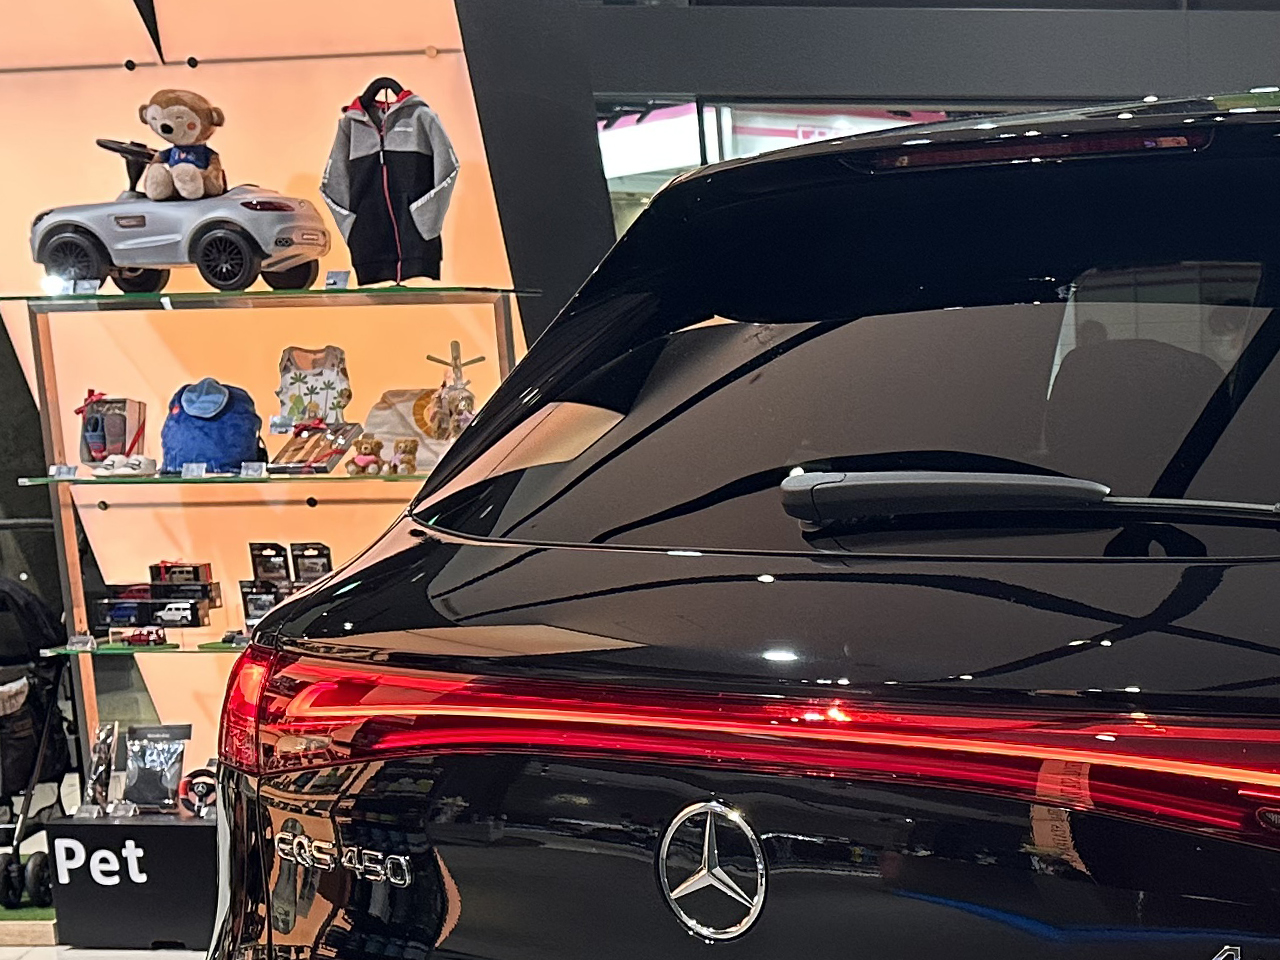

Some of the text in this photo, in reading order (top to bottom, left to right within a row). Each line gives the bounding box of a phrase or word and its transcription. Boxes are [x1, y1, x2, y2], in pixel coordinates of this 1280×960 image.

[54, 837, 148, 886] Pet
[274, 831, 412, 889] EQS 450
